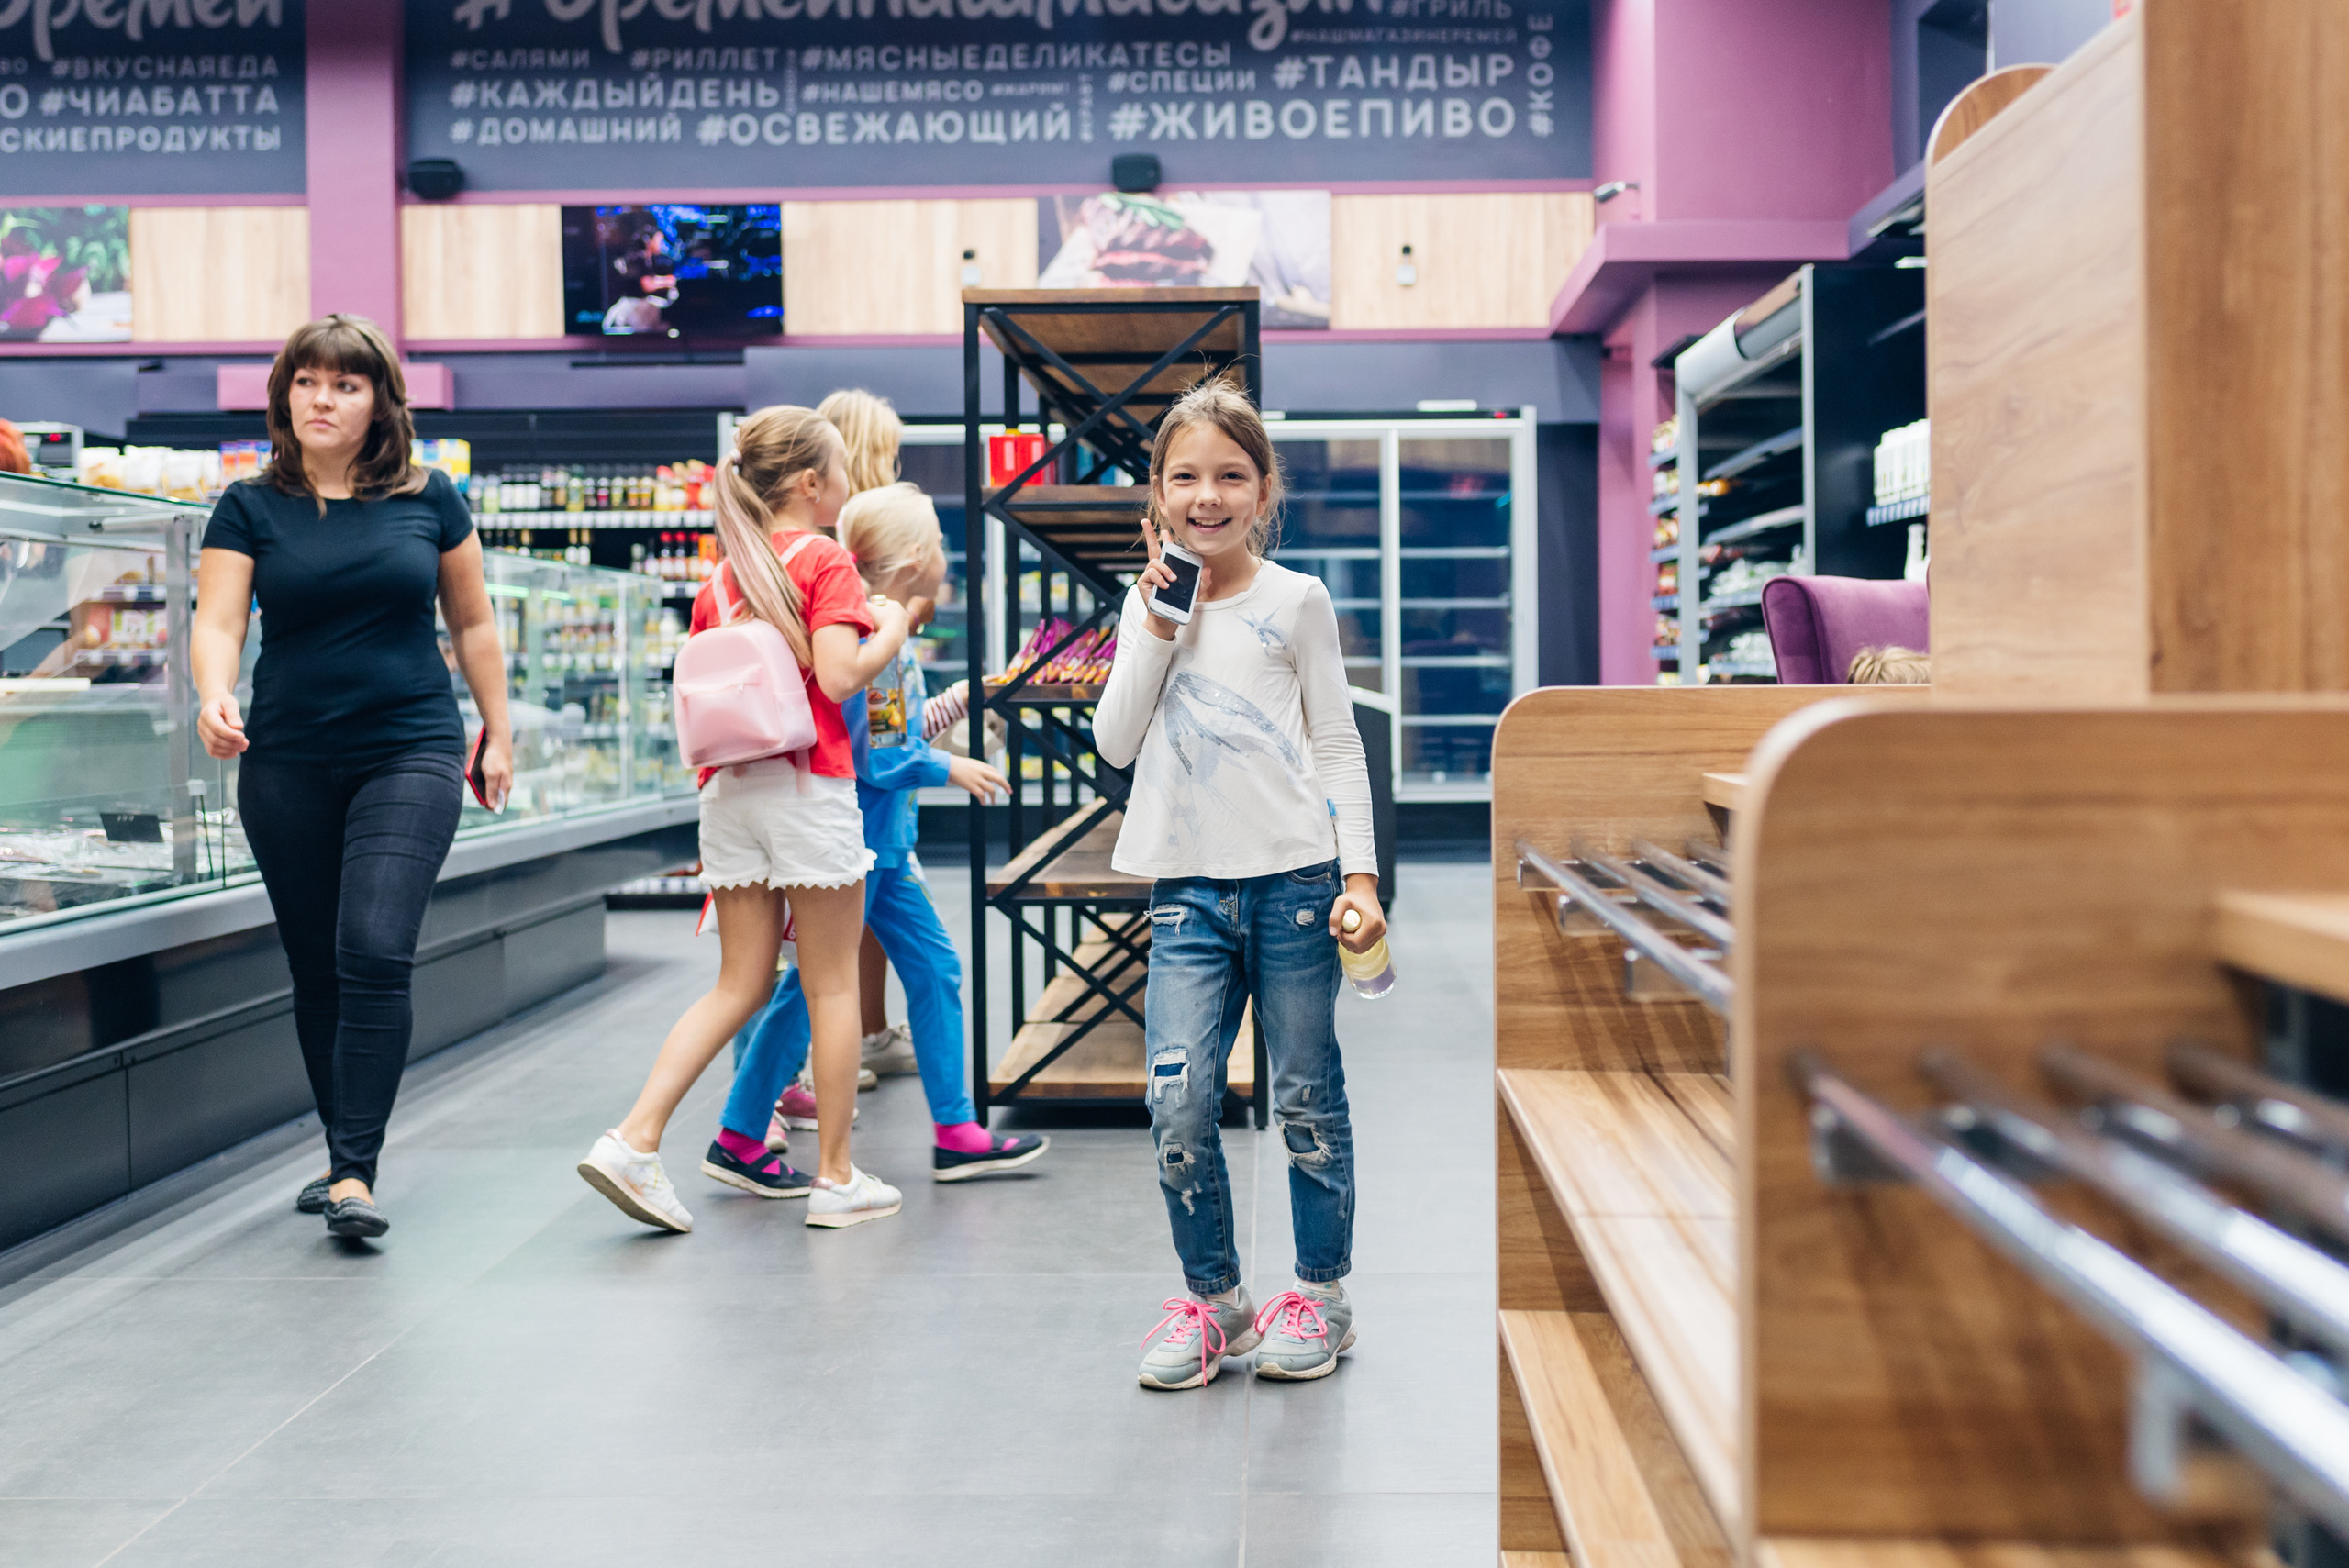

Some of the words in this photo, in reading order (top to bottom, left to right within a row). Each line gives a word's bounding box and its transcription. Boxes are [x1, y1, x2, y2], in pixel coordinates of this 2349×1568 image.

[52, 55, 279, 79] #ВКУСНАЯЕДА
[451, 47, 590, 71] #САЛЯМИ
[631, 46, 778, 71] #РИЛЛЕТ
[801, 42, 1231, 72] #МЯСНЫЕДЕЛИКАТЕСЫ
[1108, 69, 1256, 94] #СПЕЦИИ
[1272, 53, 1515, 91] #ТАНДЫР
[40, 84, 279, 117] #ЧИАБАТТА
[450, 72, 780, 111] #КАЖДЫЙДЕНЬ
[802, 79, 984, 104] #НАШЕМЯСО
[450, 111, 682, 146] #ДОМАШНИЙ
[696, 102, 1071, 147] #ОСВЕЖАЮЩИЙ
[1107, 97, 1515, 141] #ЖИВОЕПИВО
[0, 125, 281, 153] СКИЕПРОДУКТЫ
